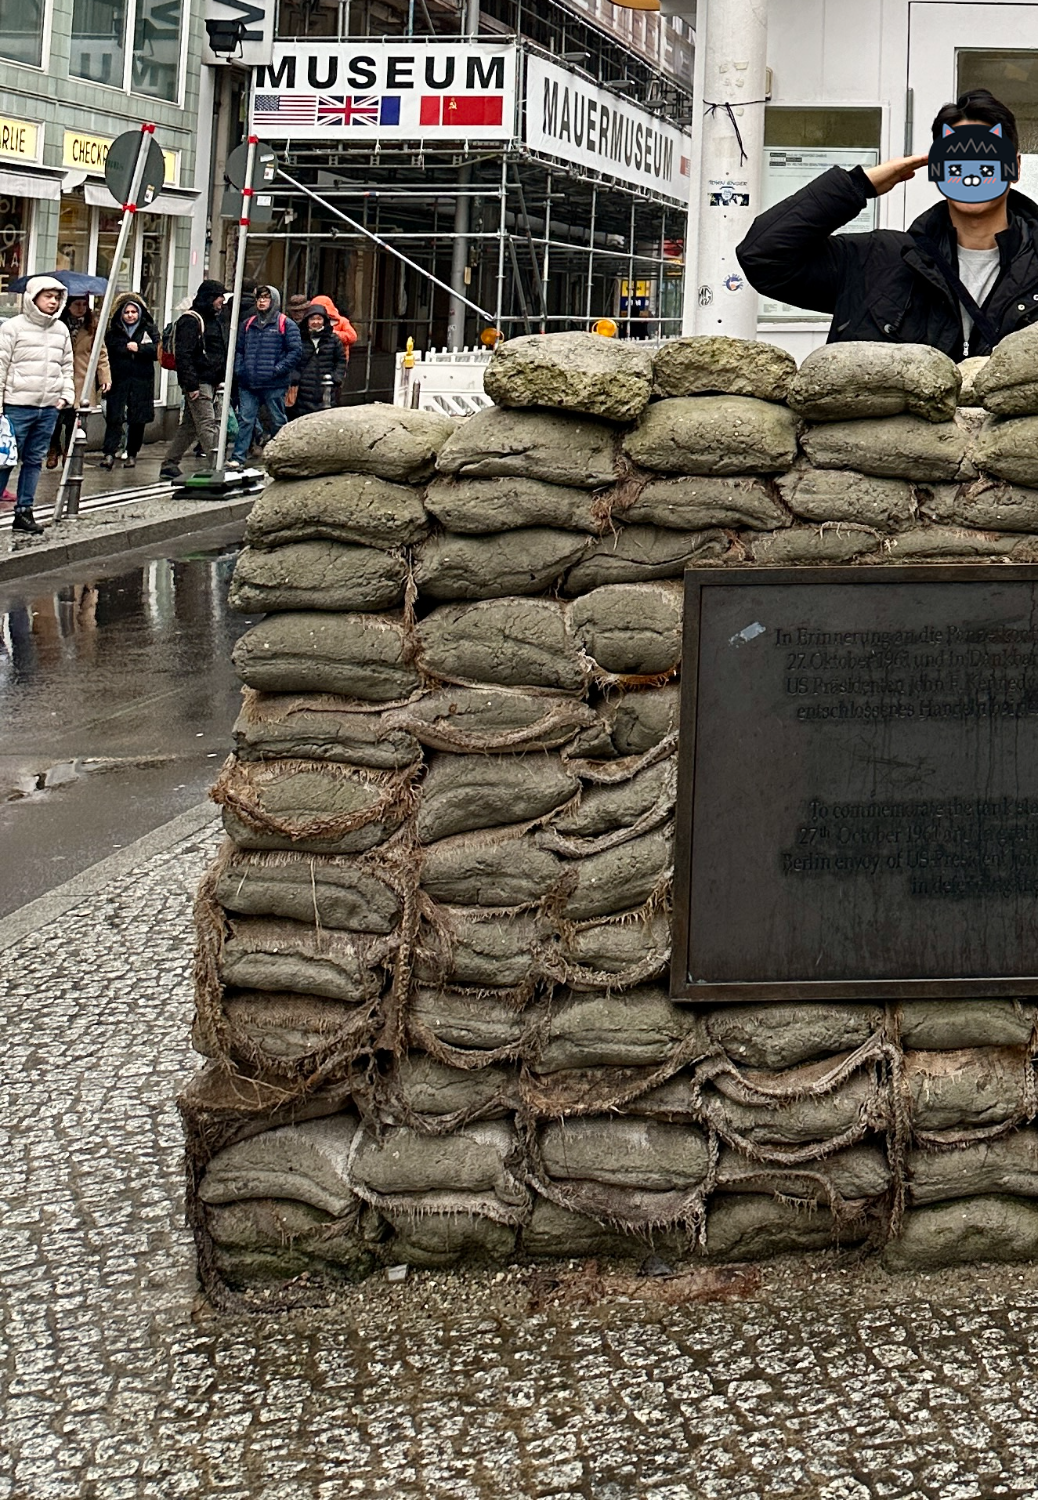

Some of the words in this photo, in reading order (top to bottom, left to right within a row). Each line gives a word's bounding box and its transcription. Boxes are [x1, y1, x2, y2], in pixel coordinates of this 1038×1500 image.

[256, 55, 505, 90] MUSEUM
[542, 76, 674, 182] MAUERMUSEUM
[775, 628, 792, 646] In
[797, 628, 891, 650] Erinnerung
[919, 626, 943, 645] die
[786, 676, 808, 694] US
[811, 800, 829, 819] To
[780, 851, 830, 873] Berlin
[835, 853, 880, 875] envoy
